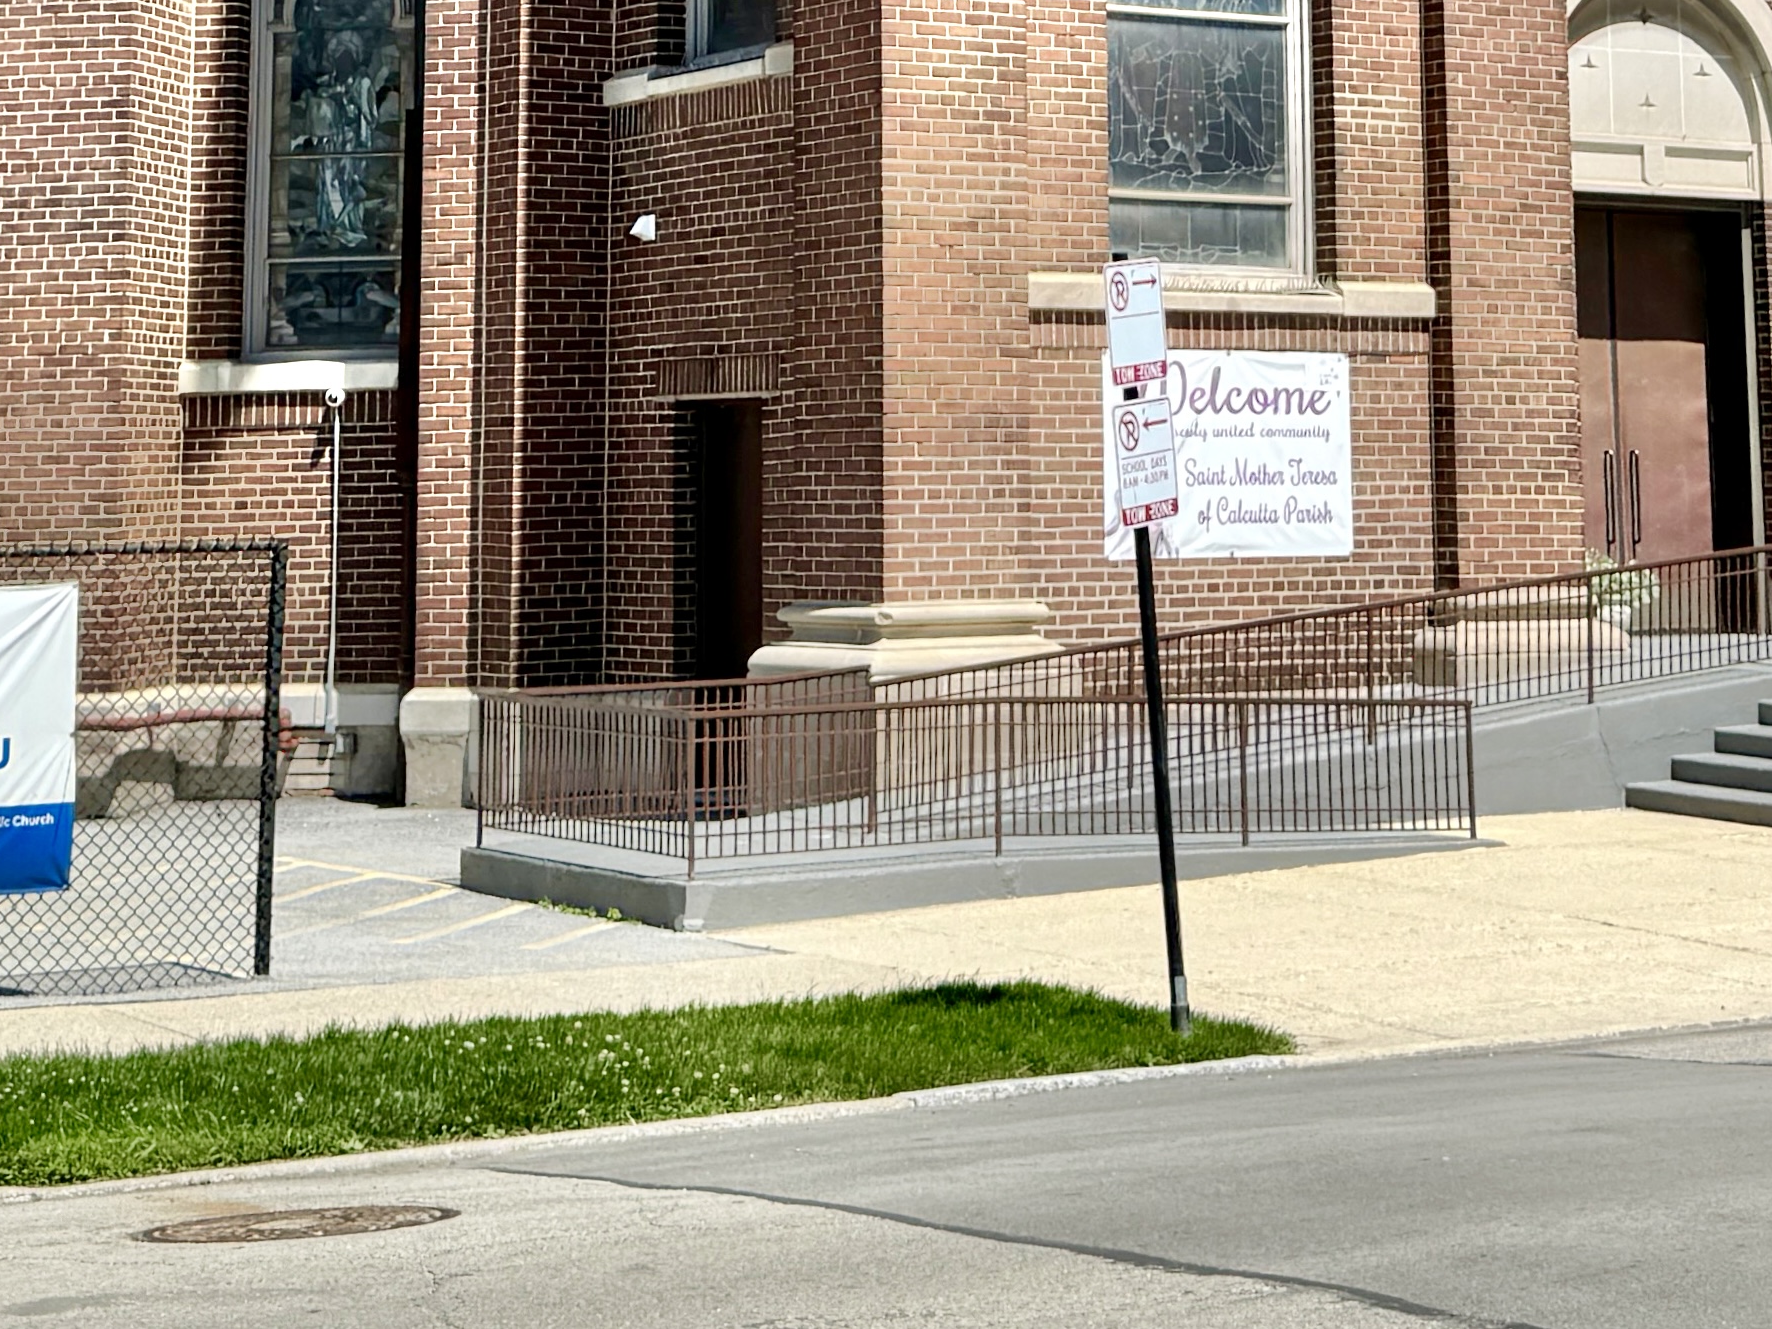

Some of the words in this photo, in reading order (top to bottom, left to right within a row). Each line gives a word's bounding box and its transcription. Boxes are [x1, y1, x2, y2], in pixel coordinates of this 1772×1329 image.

[1260, 425, 1330, 443] community
[1184, 458, 1227, 487] Saint
[1229, 457, 1285, 486] Mother
[1288, 458, 1338, 486] Teresa
[1198, 499, 1211, 533] of
[1216, 496, 1279, 525] Calcutta
[1284, 496, 1333, 525] Parish
[12, 813, 54, 827] Church
